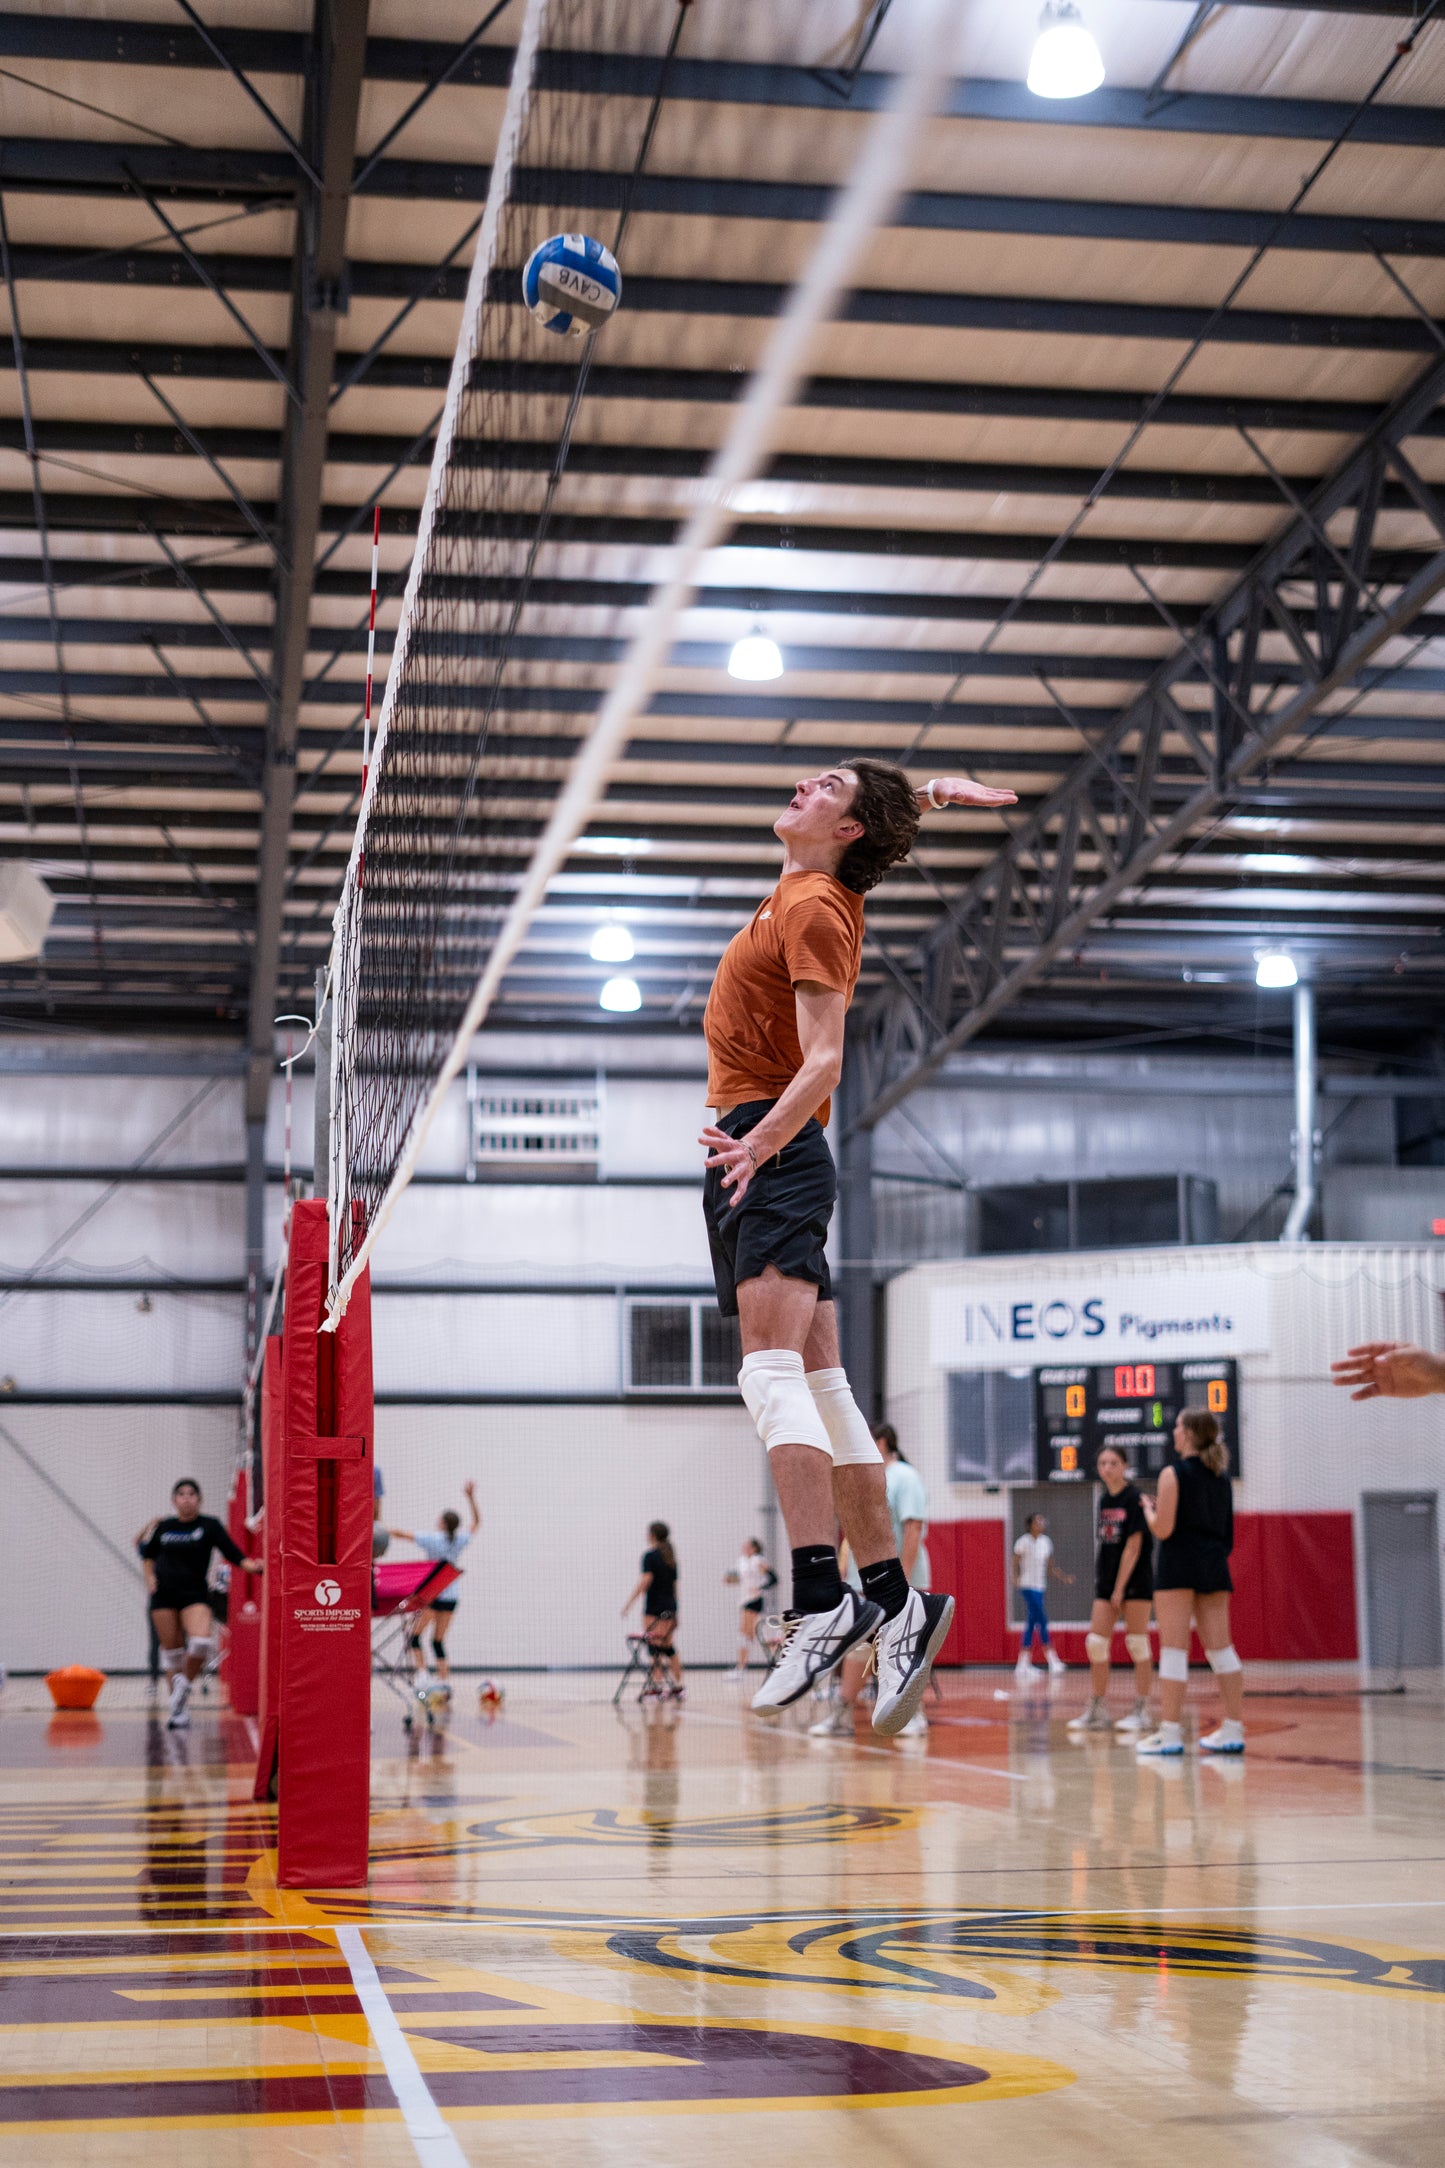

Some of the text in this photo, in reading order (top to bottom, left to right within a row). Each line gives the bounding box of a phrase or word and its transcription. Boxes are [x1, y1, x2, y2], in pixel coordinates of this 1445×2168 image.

[560, 268, 600, 301] CAVB
[965, 1299, 1232, 1342] INEOS Pigments
[1066, 1385, 1086, 1417] 0
[1207, 1380, 1228, 1412] 0
[294, 1609, 361, 1619] SPORTS IMPORTS
